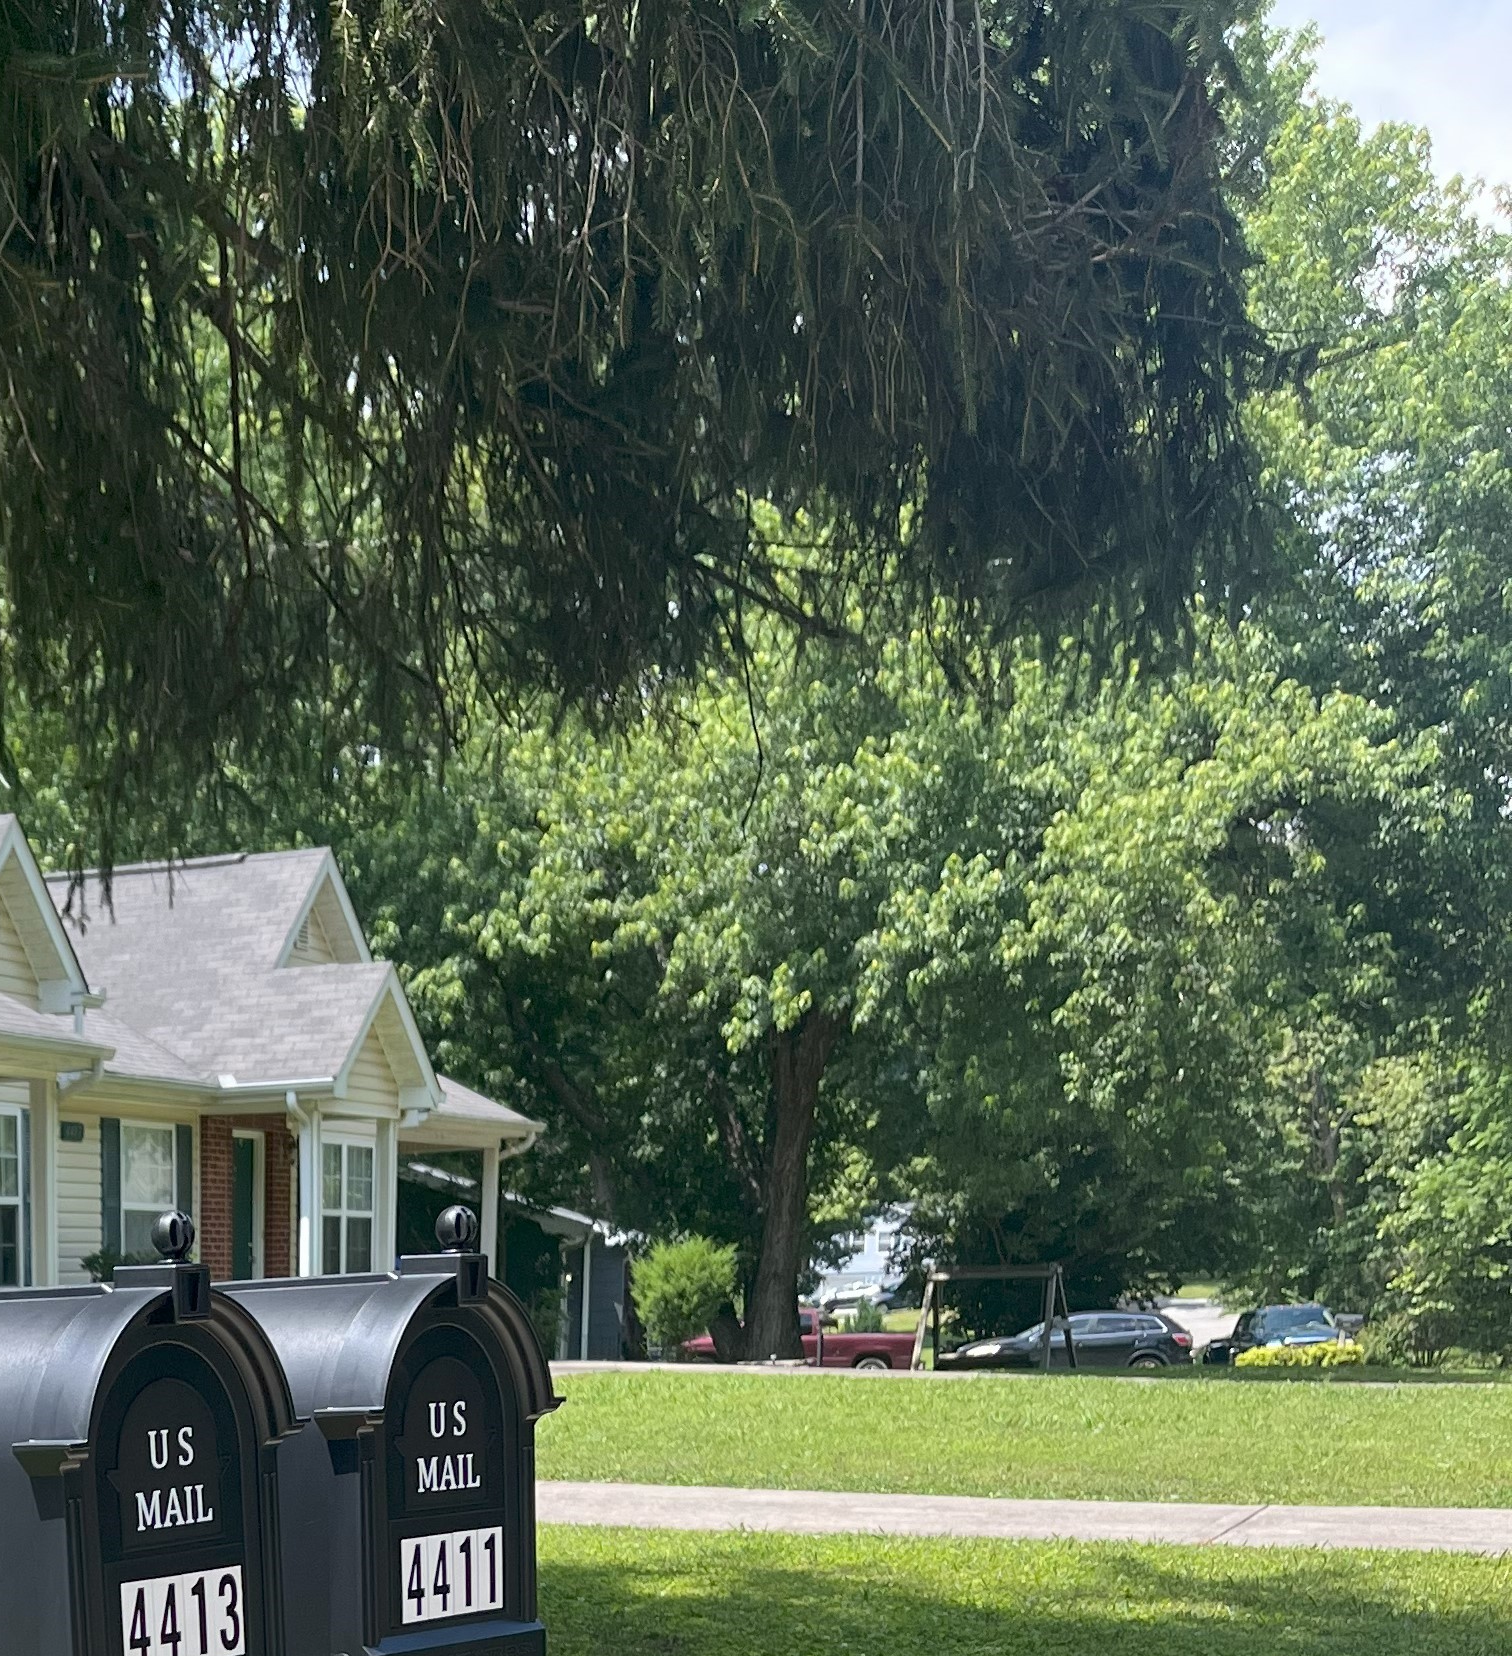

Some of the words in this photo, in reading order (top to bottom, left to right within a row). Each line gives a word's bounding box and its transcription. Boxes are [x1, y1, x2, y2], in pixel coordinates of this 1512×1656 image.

[417, 1453, 481, 1493] MAIL
[135, 1484, 214, 1532] MAIL
[407, 1532, 498, 1617] 4411
